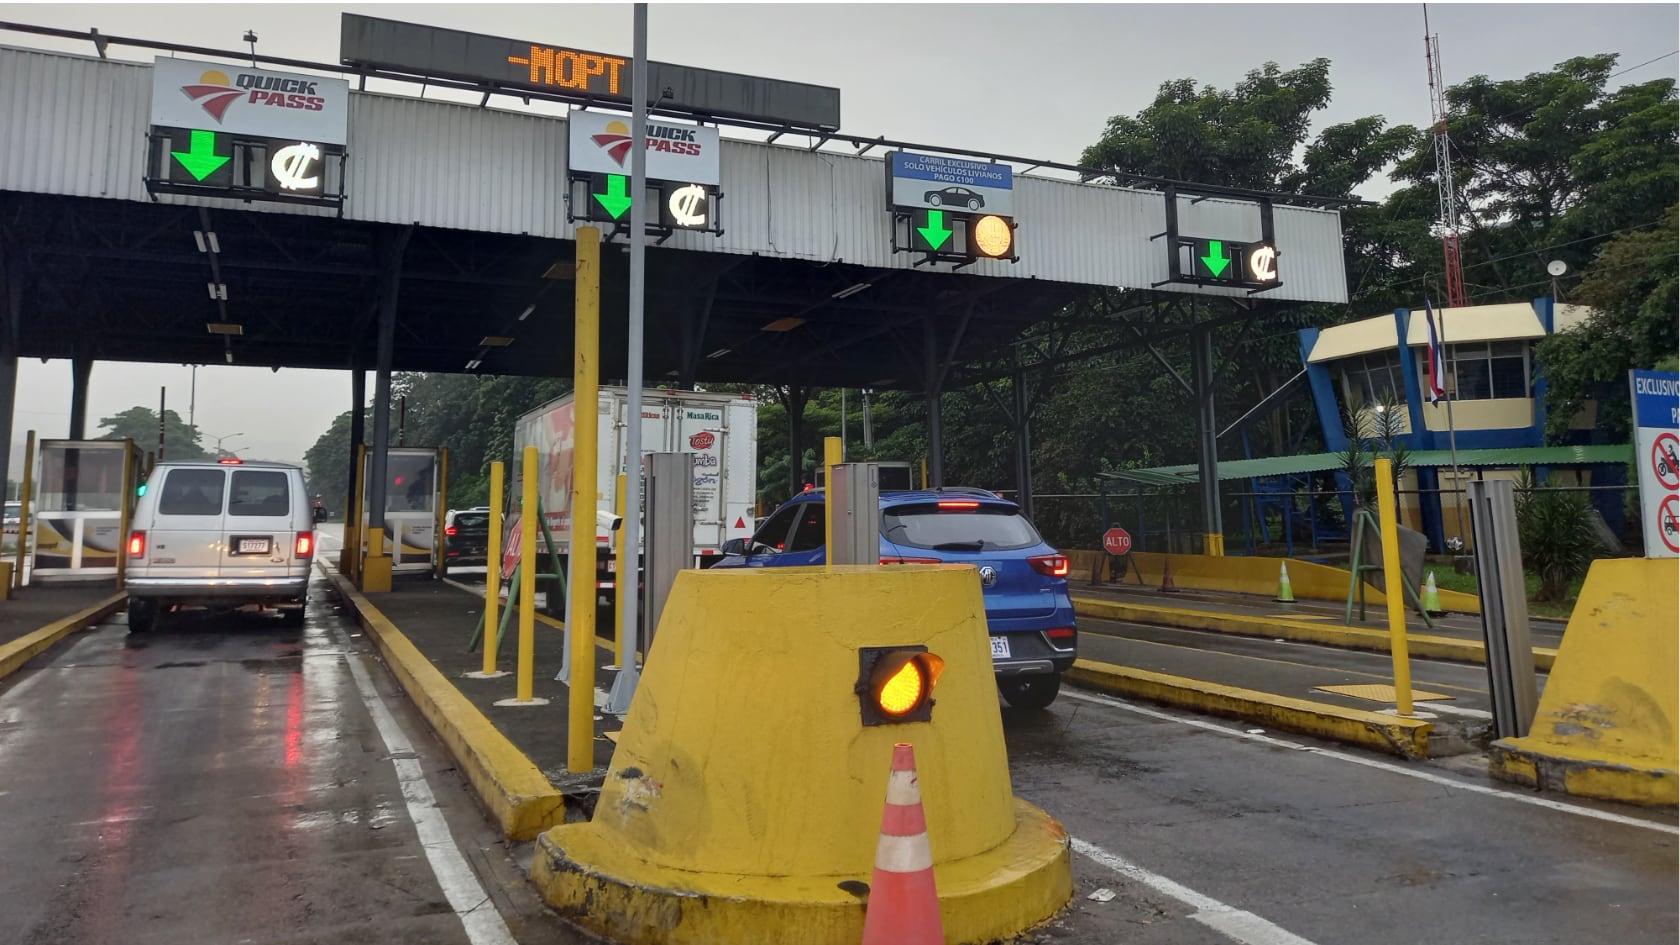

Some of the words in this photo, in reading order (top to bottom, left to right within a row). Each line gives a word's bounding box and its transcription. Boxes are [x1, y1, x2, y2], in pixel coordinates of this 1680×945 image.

[236, 73, 318, 95] QUICK
[248, 90, 325, 111] PASS
[646, 124, 697, 142] UICK
[904, 161, 925, 170] SOLO
[968, 169, 1003, 180] LIVIANOS
[919, 156, 946, 166] CARRIL
[947, 159, 988, 171] EXCLUSIVO
[934, 173, 955, 182] PAGO
[1106, 536, 1130, 547] ALTO
